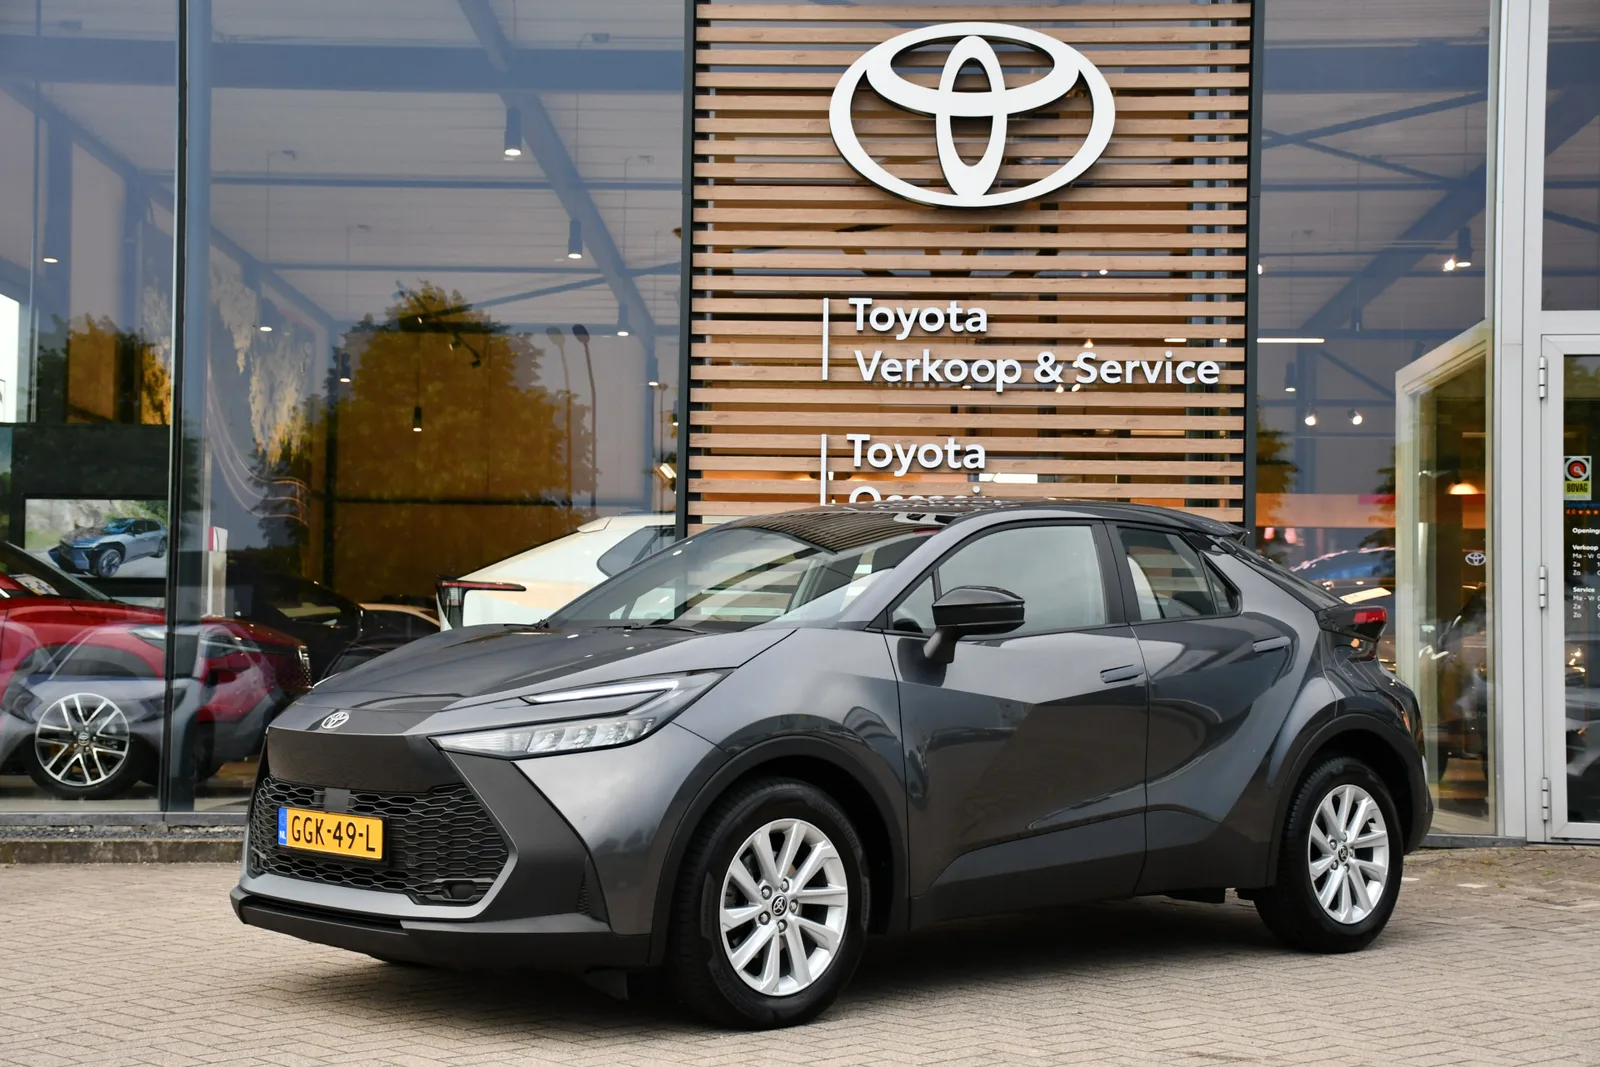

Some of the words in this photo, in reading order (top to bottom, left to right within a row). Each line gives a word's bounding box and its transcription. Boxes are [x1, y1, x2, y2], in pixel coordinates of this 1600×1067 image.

[848, 298, 988, 340] Toyota
[854, 349, 1022, 393] Verkoop
[1033, 351, 1064, 384] &
[1075, 350, 1220, 385] Service
[846, 433, 986, 477] Toyota
[1567, 483, 1588, 492] BOVAG
[291, 815, 376, 852] GGK-49-L
